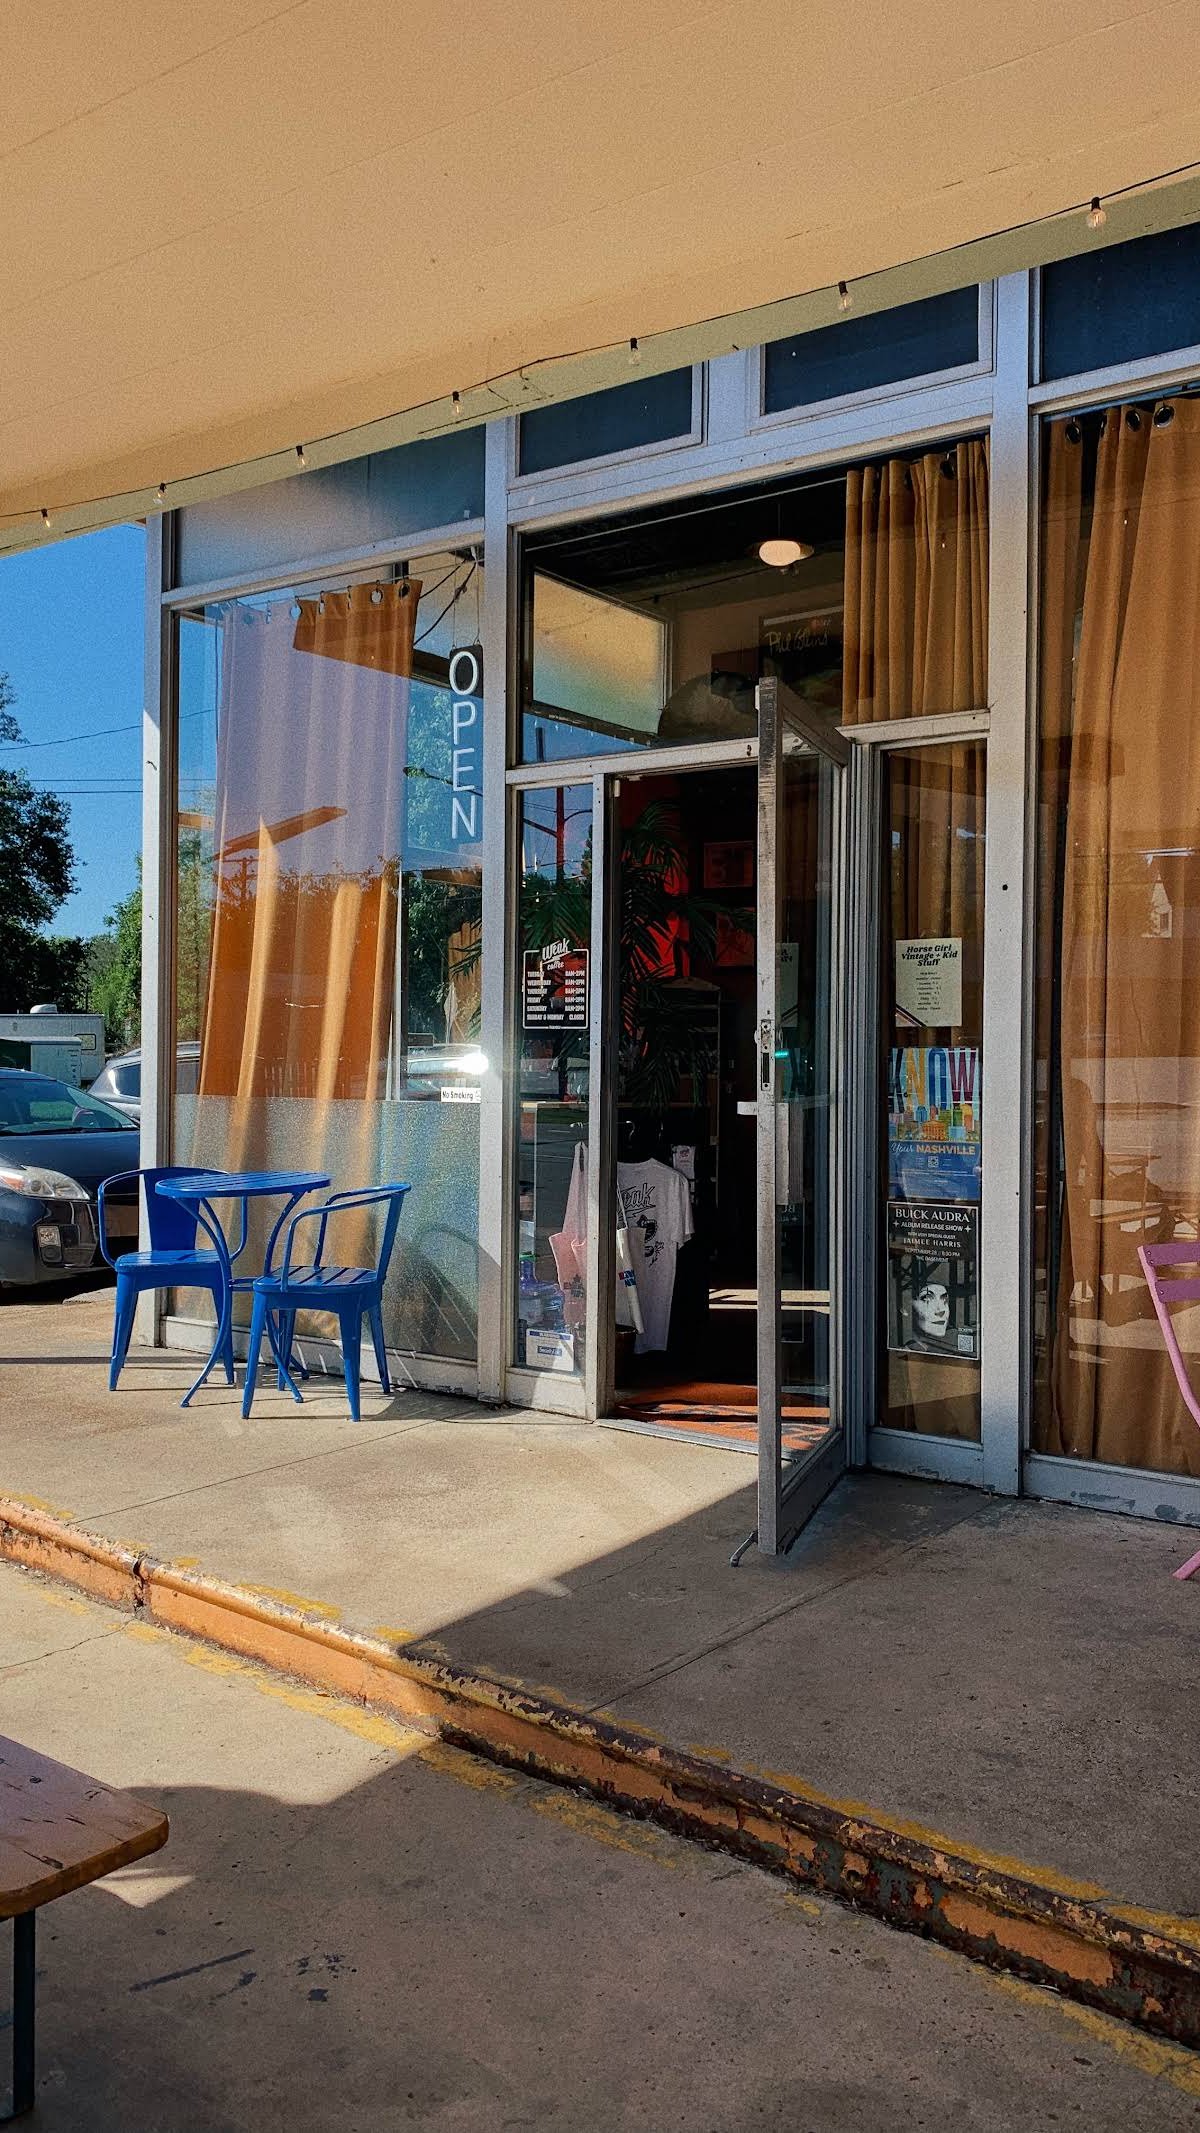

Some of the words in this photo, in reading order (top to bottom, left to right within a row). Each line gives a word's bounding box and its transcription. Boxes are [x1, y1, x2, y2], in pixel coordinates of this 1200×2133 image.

[449, 651, 478, 840] OPEN
[542, 938, 570, 961] Weak
[934, 944, 952, 952] Girl
[901, 952, 934, 961] Vintage
[942, 951, 958, 959] Kid
[917, 958, 941, 967] Stuff
[568, 1013, 585, 1021] CLOSED
[888, 1048, 977, 1114] KNOW
[442, 1090, 449, 1099] No
[450, 1090, 474, 1101] Smoking
[890, 1142, 913, 1156] Your
[916, 1144, 976, 1155] NASHVILLE
[619, 1183, 656, 1209] eak
[895, 1208, 929, 1220] BUICK
[931, 1211, 970, 1223] AUDRA
[900, 1221, 920, 1229] ALBUM
[920, 1222, 945, 1231] RELEASE
[945, 1224, 964, 1232] SHOW
[933, 1239, 961, 1248] HARRIS
